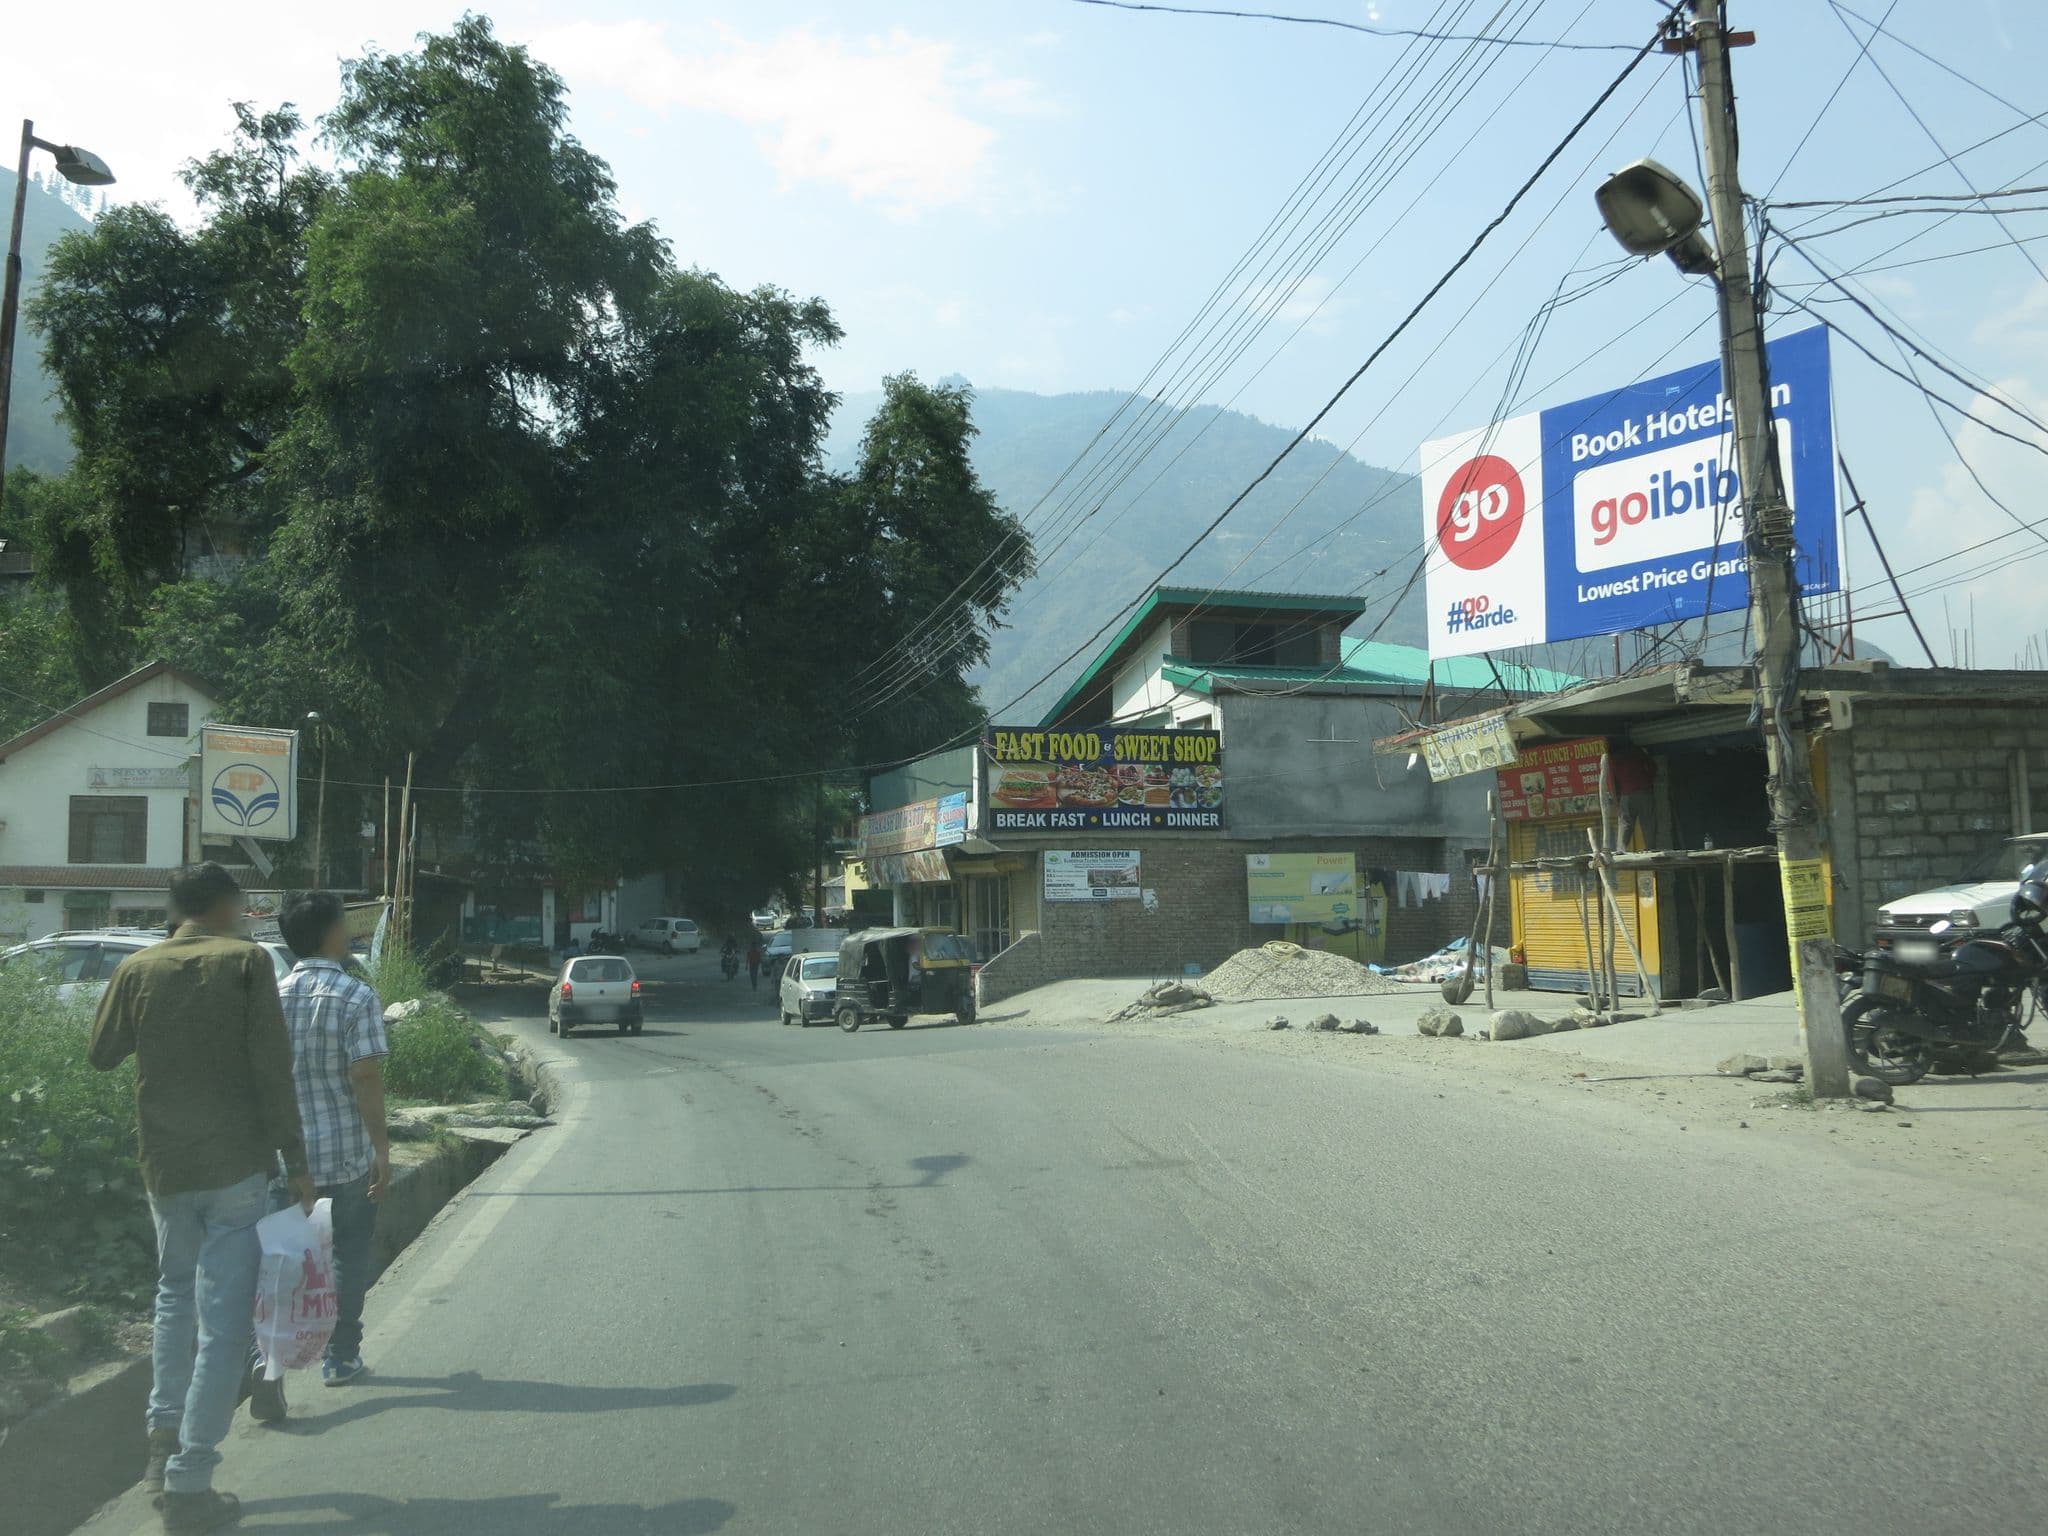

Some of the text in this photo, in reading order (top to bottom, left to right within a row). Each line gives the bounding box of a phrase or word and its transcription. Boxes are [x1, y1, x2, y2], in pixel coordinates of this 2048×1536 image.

[1572, 383, 1791, 462] Book Hotels n
[1451, 483, 1509, 542] go
[1591, 458, 1740, 546] goibib
[1577, 576, 1639, 602] Lowest
[1642, 567, 1688, 591] Price
[995, 732, 1217, 762] FAST FOOD & SWEET SHOP
[1543, 747, 1569, 764] LUNCH
[996, 813, 1219, 828] BREAK FAST LUNCH DINNER
